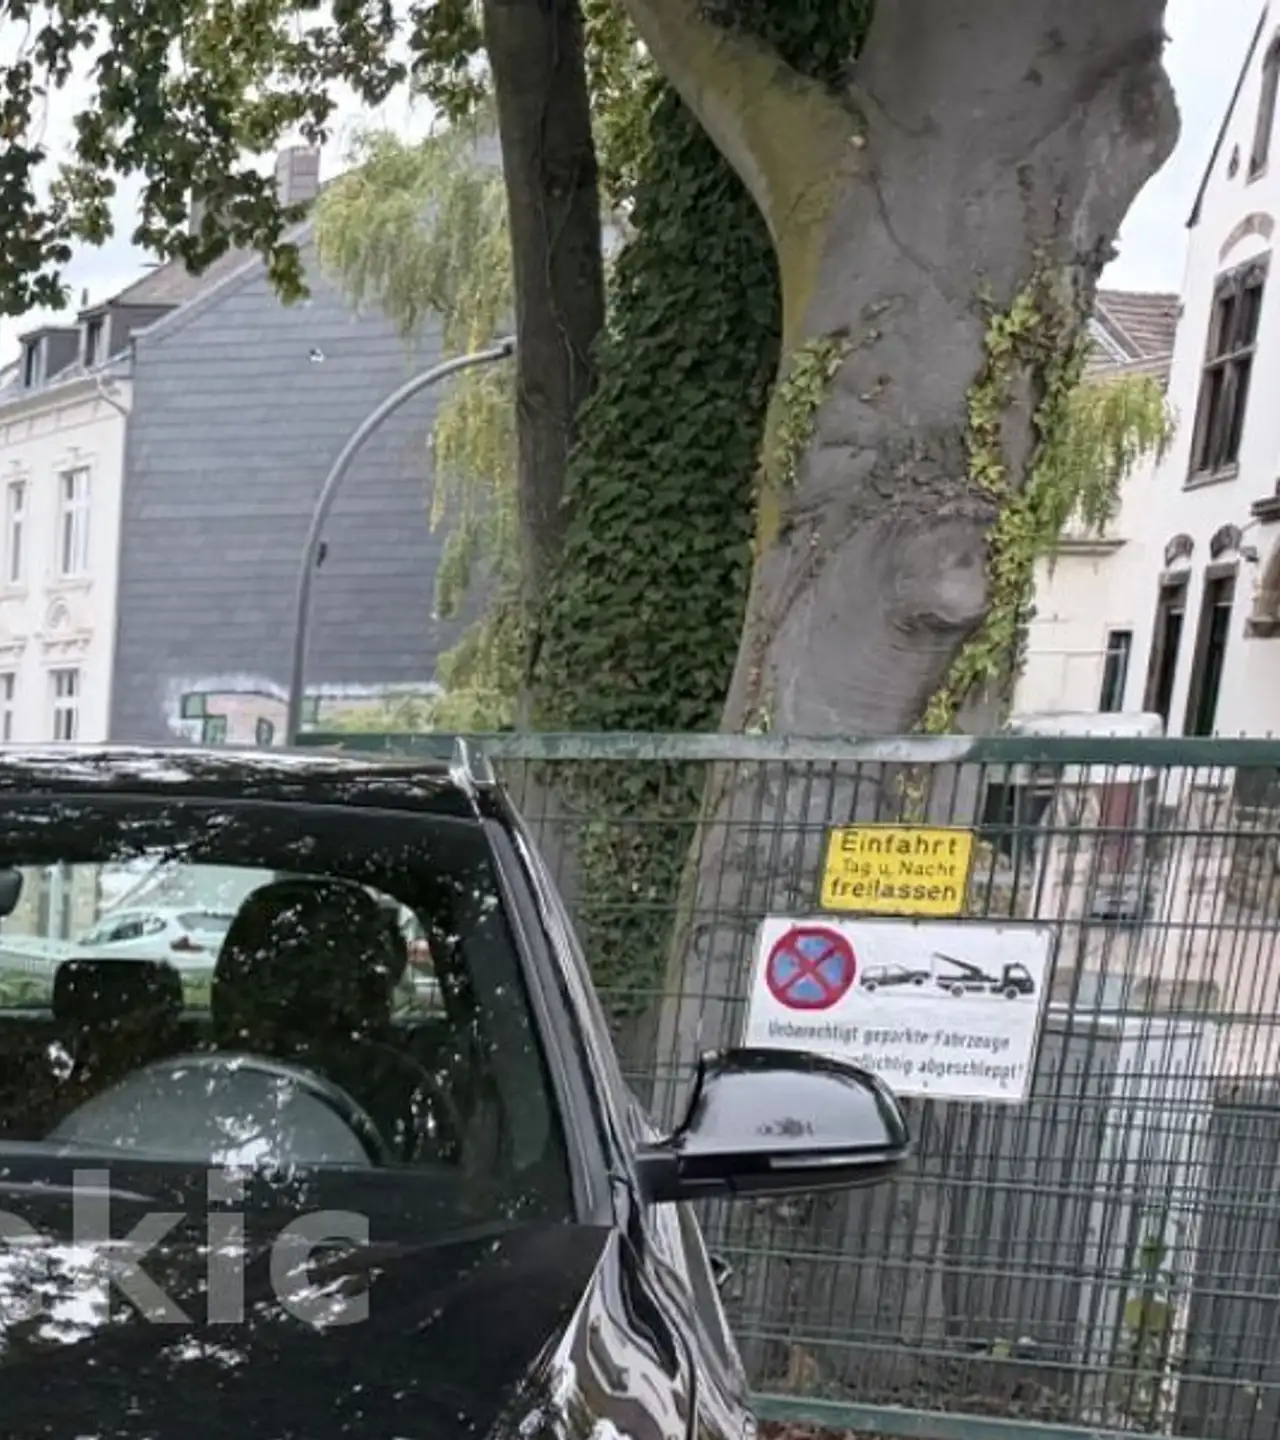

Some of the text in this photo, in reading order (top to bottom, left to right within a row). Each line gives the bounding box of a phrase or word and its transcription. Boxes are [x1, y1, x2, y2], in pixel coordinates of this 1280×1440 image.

[840, 830, 957, 855] Einfahrt
[843, 858, 872, 878] Tag
[898, 860, 957, 877] Nacht
[831, 877, 958, 901] freilassen
